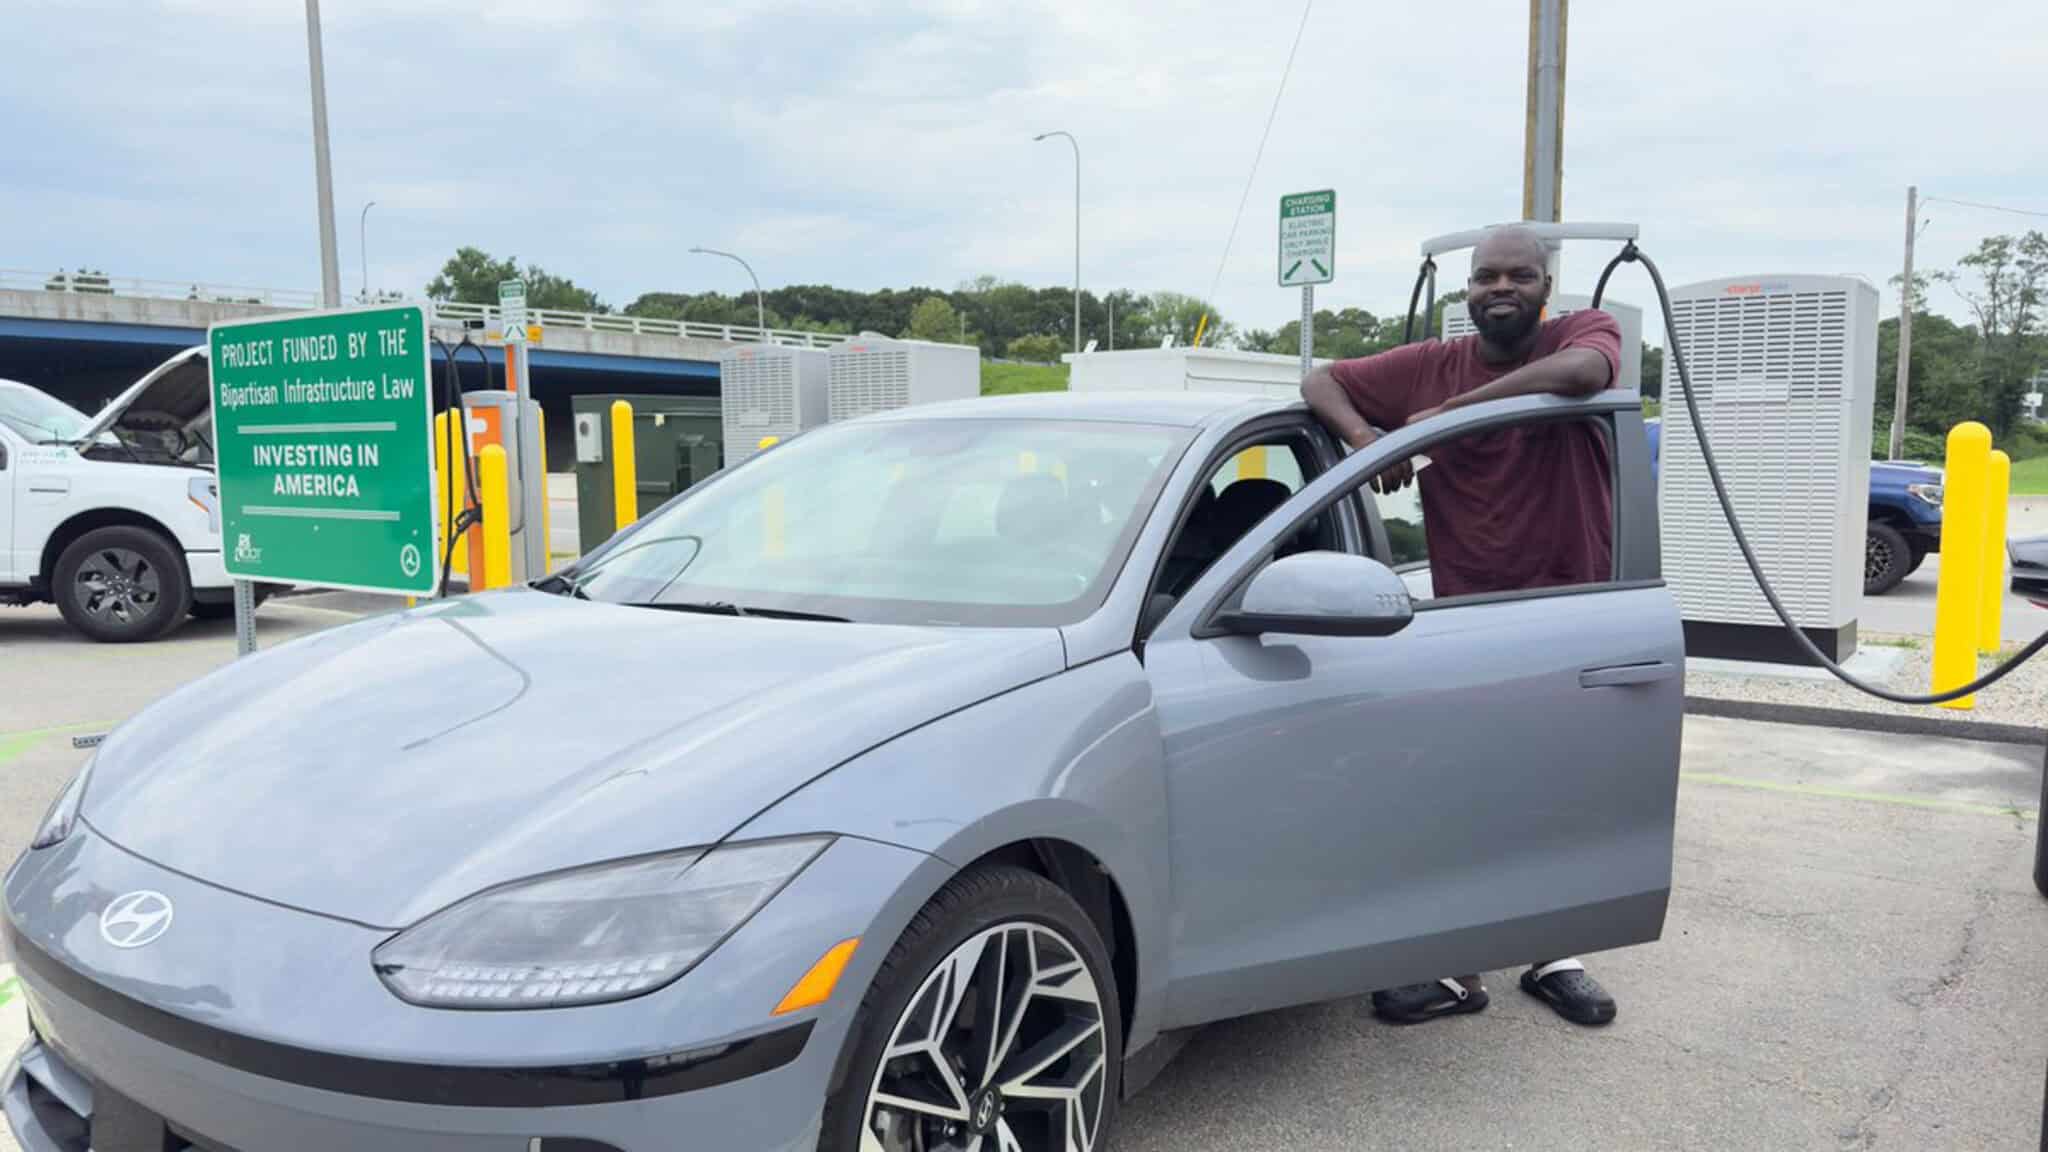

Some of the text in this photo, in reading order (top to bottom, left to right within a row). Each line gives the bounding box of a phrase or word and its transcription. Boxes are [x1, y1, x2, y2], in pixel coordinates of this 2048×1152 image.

[1290, 204, 1326, 215] STATION
[221, 328, 408, 368] PROJECT FUNDED BY THE
[220, 373, 414, 411] Bipartisan Infrastructure Law
[253, 444, 379, 467] INVESTING IN
[273, 474, 360, 497] AMERICA
